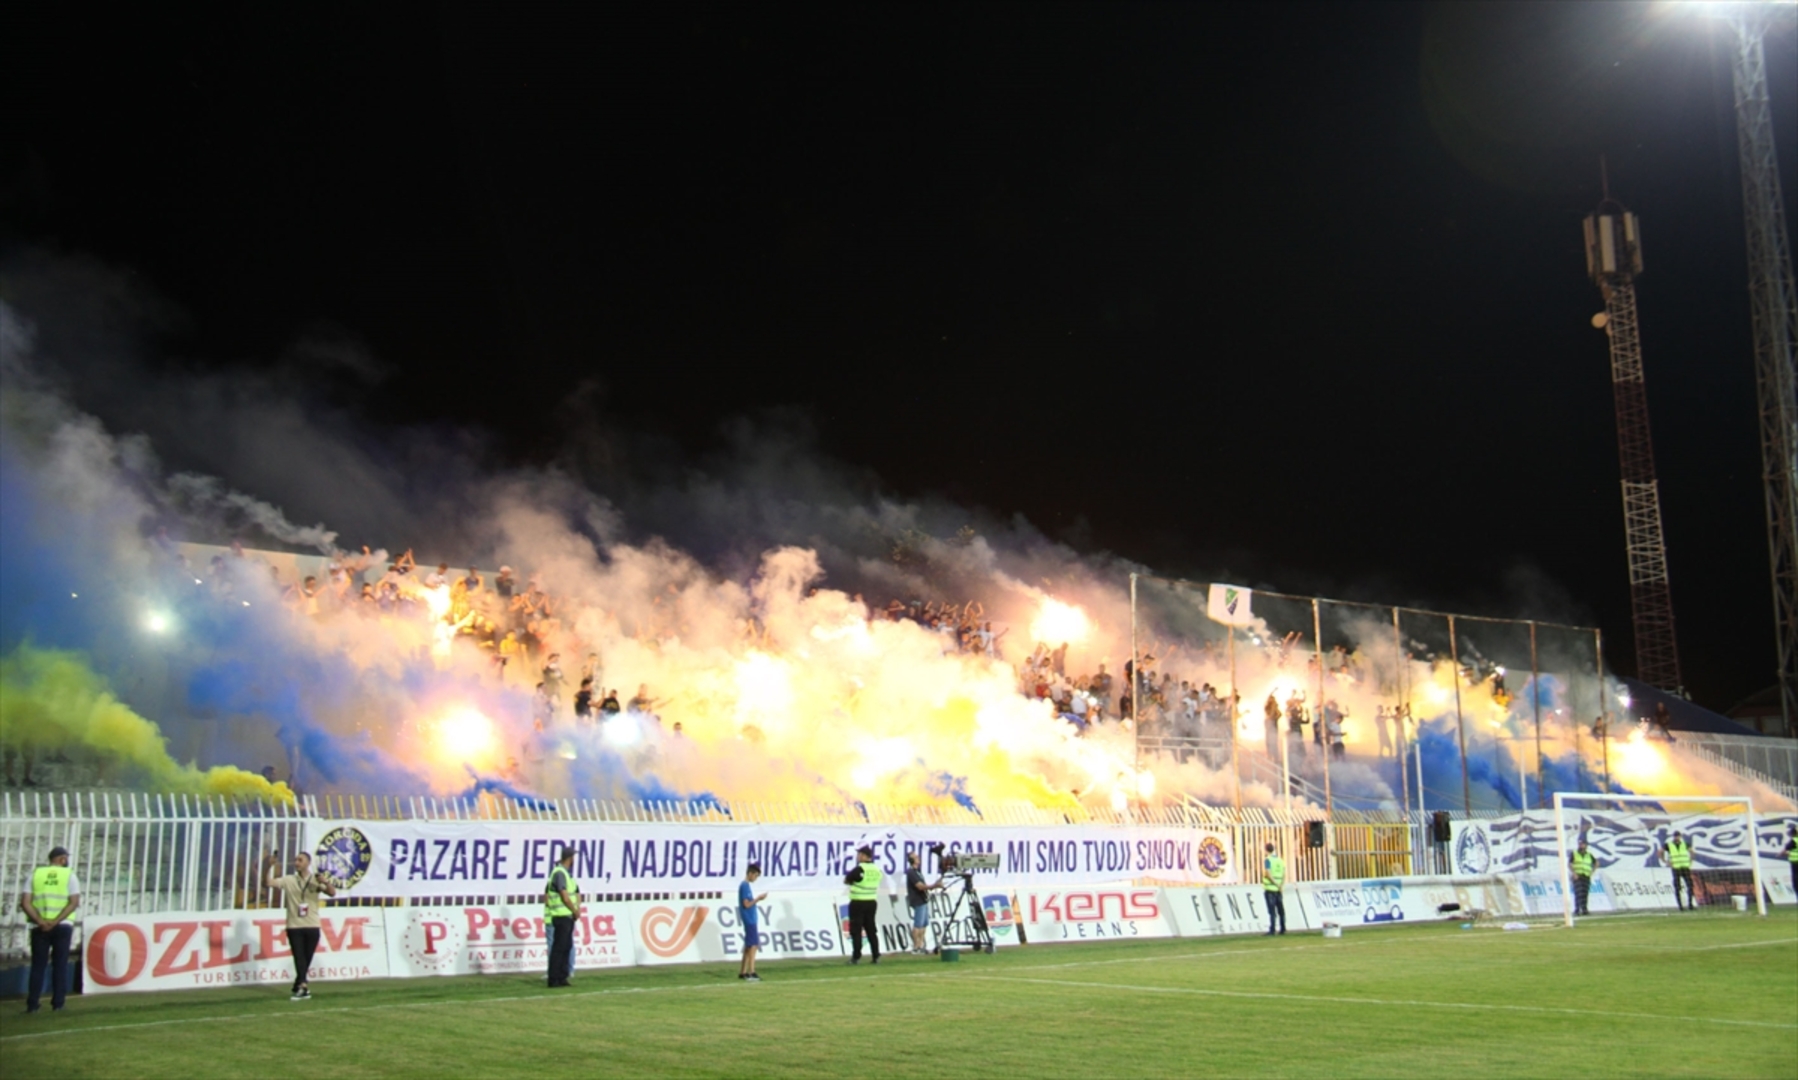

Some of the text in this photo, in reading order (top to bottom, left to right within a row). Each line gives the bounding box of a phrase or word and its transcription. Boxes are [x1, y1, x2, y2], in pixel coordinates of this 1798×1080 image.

[388, 839, 509, 880] PAZARE
[621, 840, 737, 877] NAJBOLJI
[747, 841, 818, 876] NIKAD
[1008, 840, 1030, 873] MI
[1036, 841, 1077, 872] SMO
[1083, 841, 1131, 871] TVOJI
[1136, 840, 1192, 870] SINOVI
[464, 907, 616, 945] Preja
[717, 906, 772, 928] CIY
[1062, 921, 1139, 939] JEANS
[87, 916, 371, 987] OZLEM
[421, 922, 447, 954] P
[193, 965, 371, 984] TURISTIČKA GENCIJA
